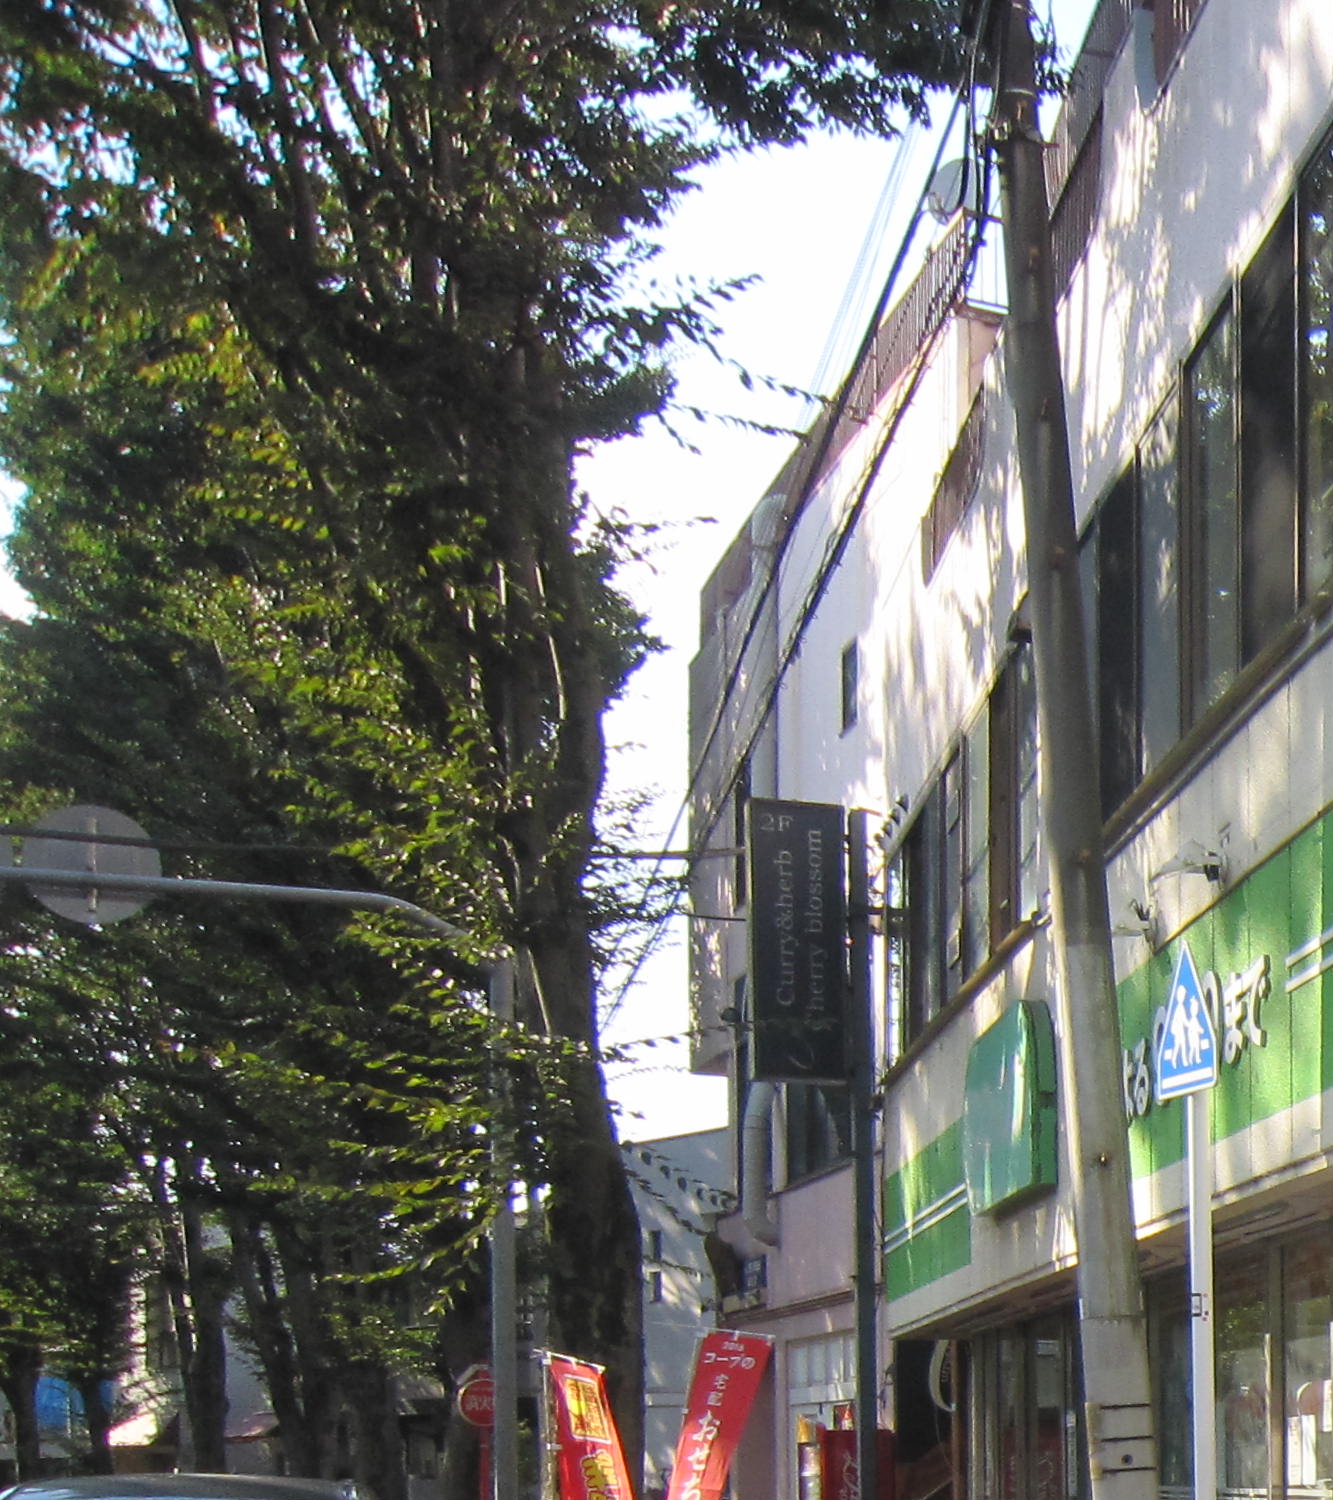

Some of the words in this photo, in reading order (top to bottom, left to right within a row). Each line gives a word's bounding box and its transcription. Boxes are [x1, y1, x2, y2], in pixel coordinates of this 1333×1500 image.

[760, 813, 795, 832] 2F
[703, 1351, 757, 1370] コープの
[465, 1393, 496, 1411] 消火
